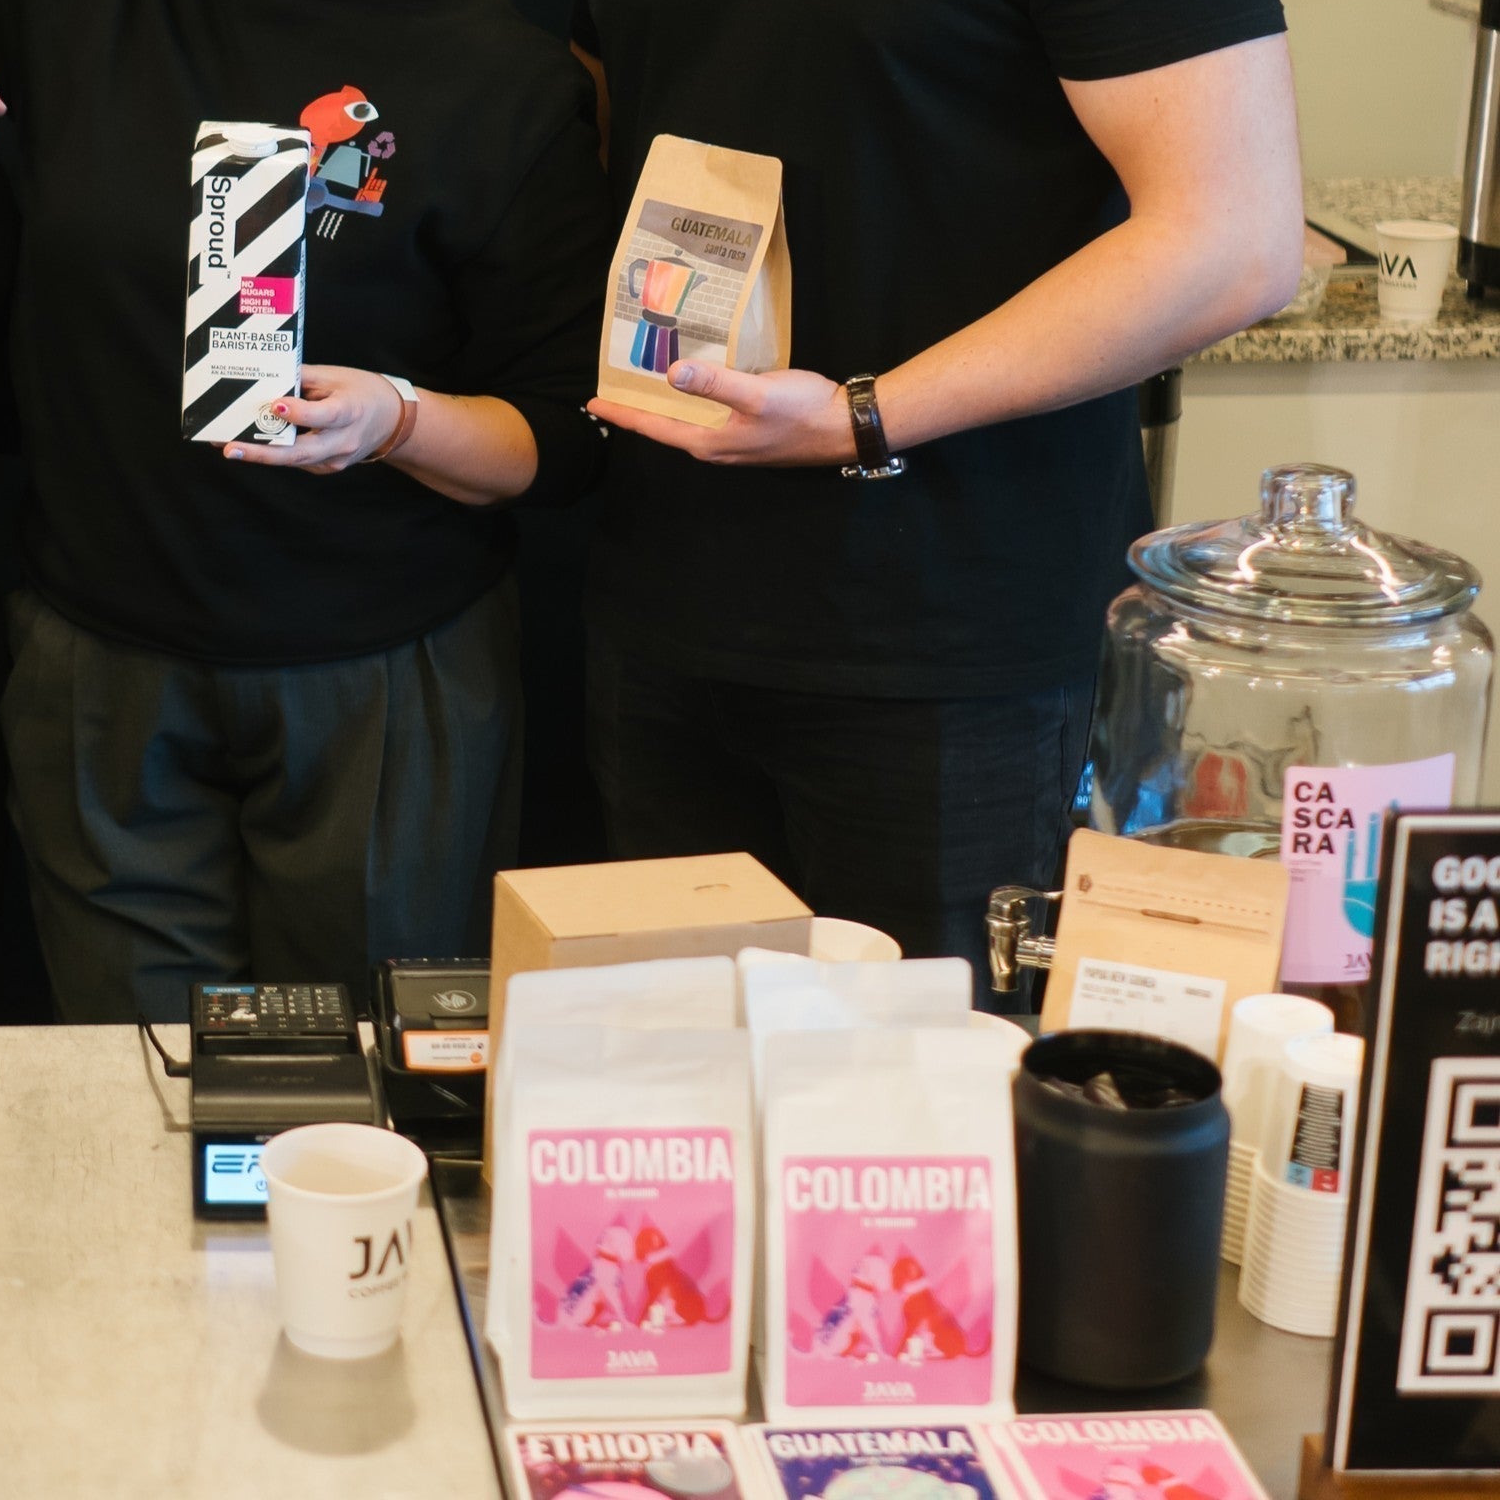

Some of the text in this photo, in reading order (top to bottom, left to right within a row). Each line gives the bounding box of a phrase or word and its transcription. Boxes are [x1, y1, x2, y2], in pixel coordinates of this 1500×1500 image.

[206, 176, 232, 269] Sproud
[671, 217, 753, 248] GUATEMALA
[704, 242, 746, 262] santa rosa
[241, 280, 254, 288] NO
[241, 288, 275, 297] SUGARS
[240, 306, 276, 314] PROTEIN
[241, 298, 271, 307] HIGH IN
[212, 330, 289, 342] PLANT-BASED
[212, 340, 291, 352] BARISTA ZERO
[1293, 781, 1334, 804] CA
[1293, 808, 1355, 829] SCA
[1291, 833, 1335, 854] RA
[1428, 898, 1499, 933] IS A
[531, 1136, 734, 1184] COLOMBIA
[785, 1165, 991, 1212] COLOMBIA
[348, 1219, 412, 1280] JA
[1011, 1418, 1221, 1443] COLOMBIA
[526, 1432, 722, 1463] ETHIOPIA
[767, 1430, 975, 1459] GUATEMALA
